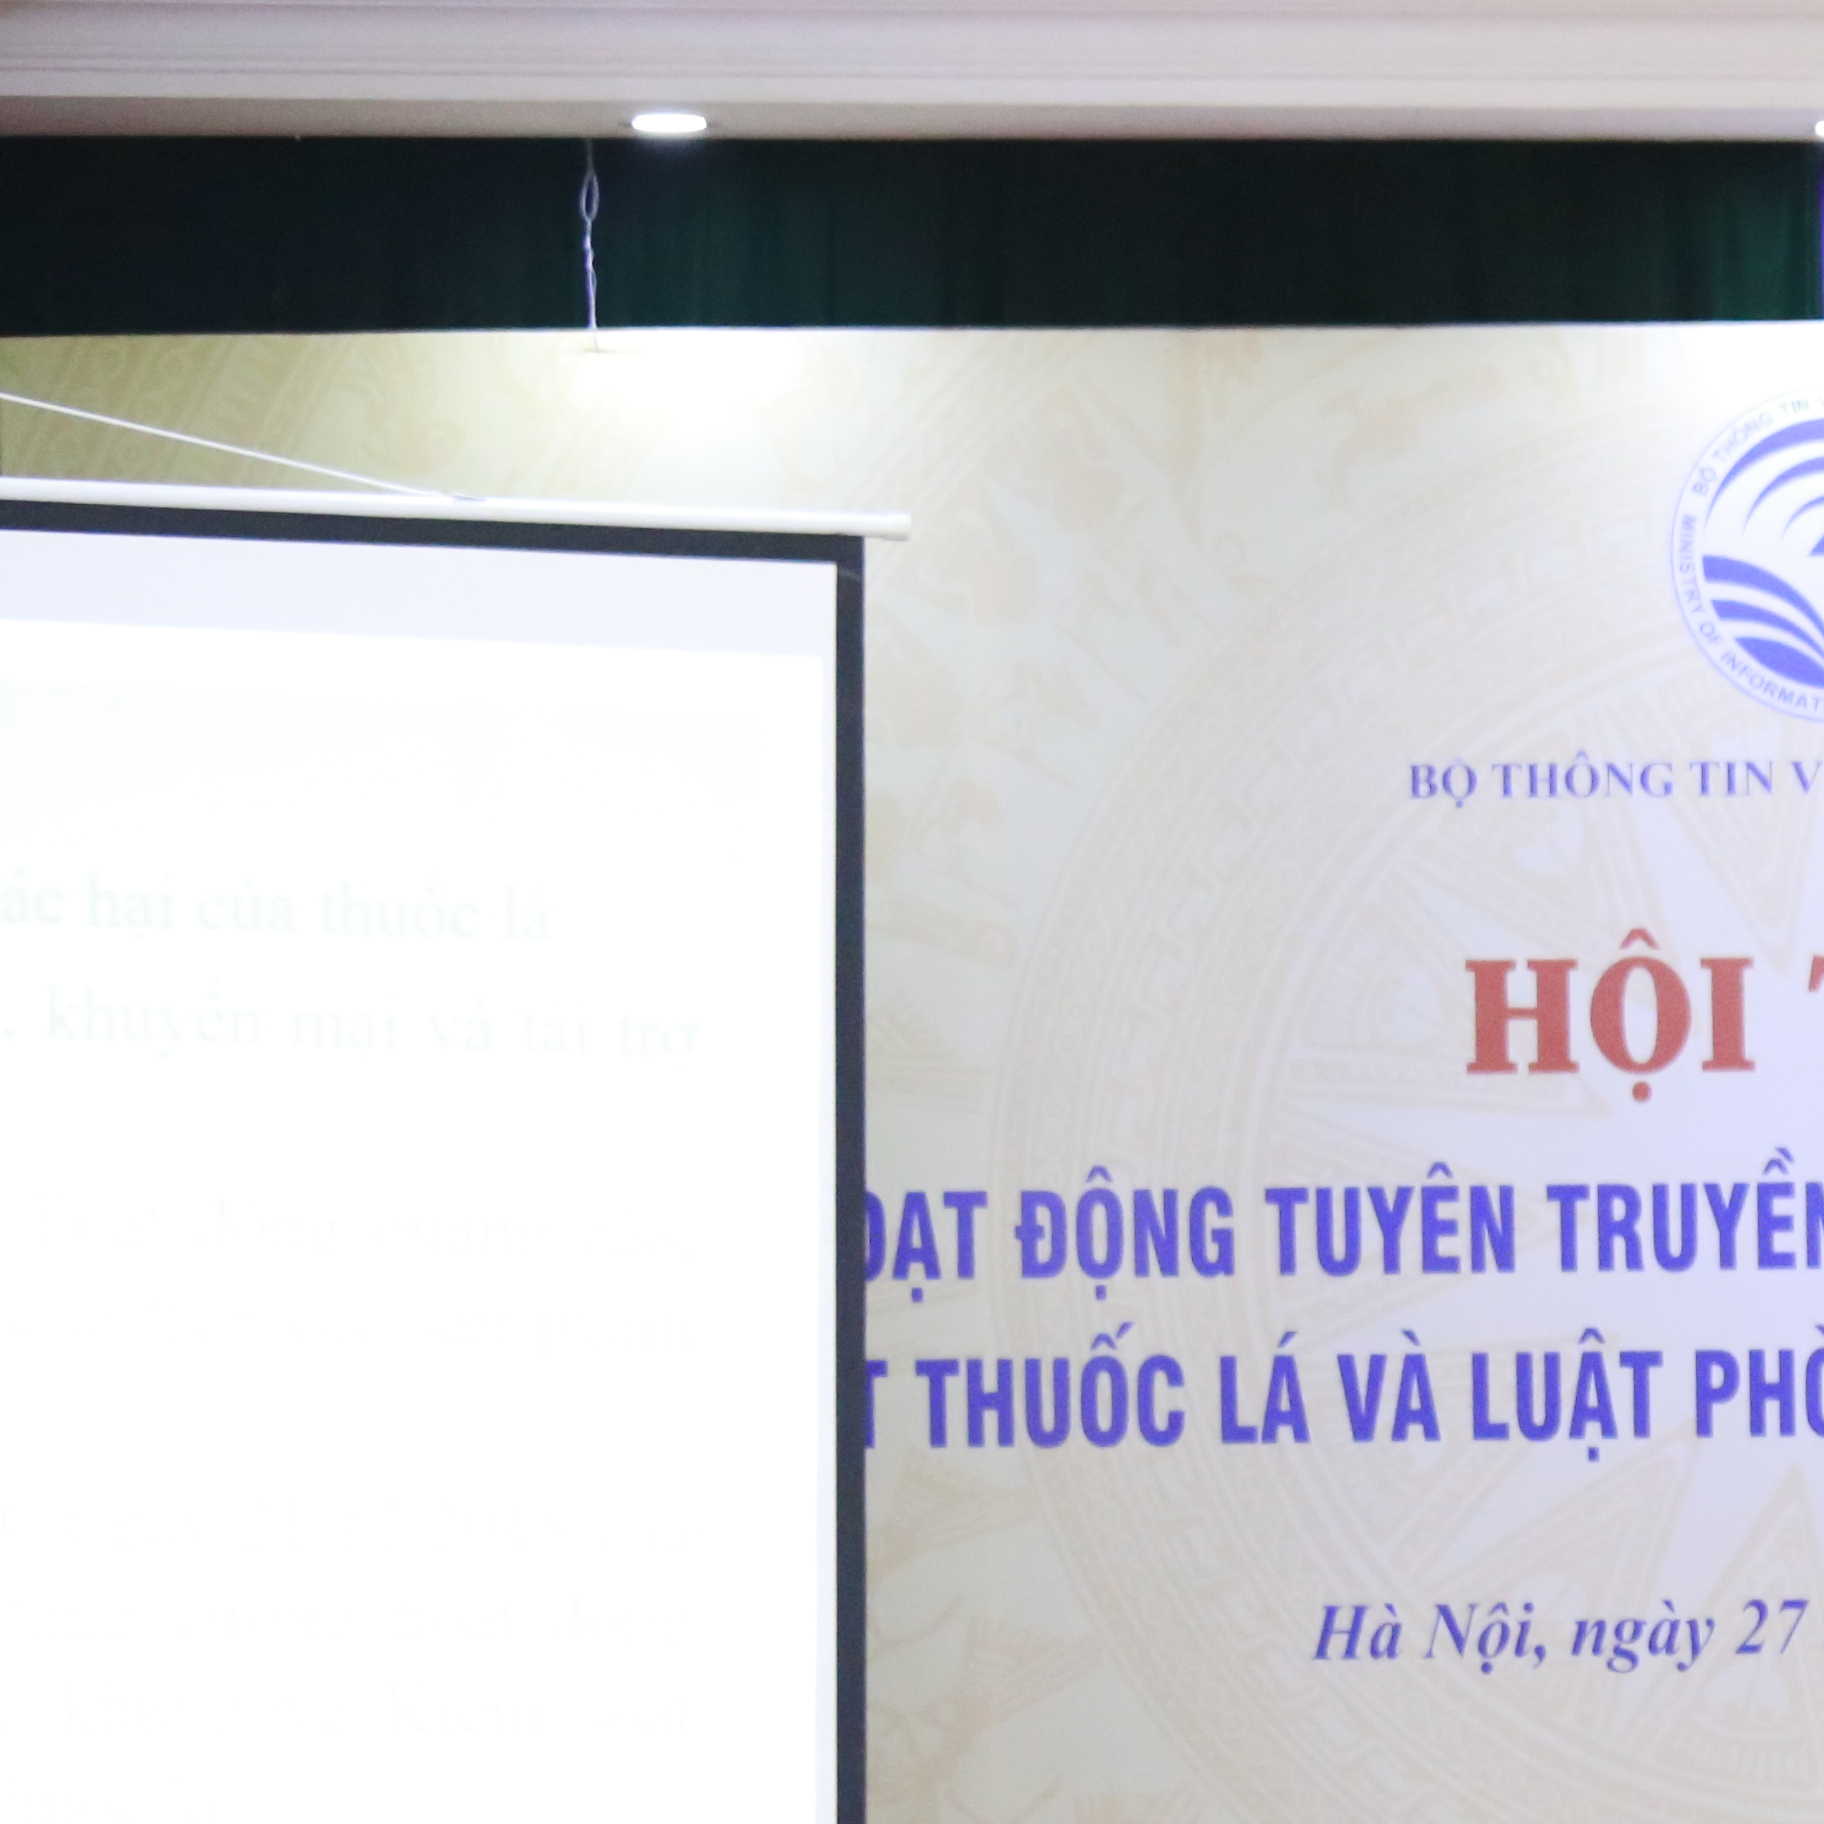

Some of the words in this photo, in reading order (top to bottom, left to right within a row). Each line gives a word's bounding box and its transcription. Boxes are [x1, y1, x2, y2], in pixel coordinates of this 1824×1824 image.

[1410, 757, 1479, 809] BỘ
[1492, 748, 1676, 800] THÔNG
[1690, 760, 1775, 797] TIN
[1465, 928, 1754, 1100] HỘI
[1015, 1166, 1234, 1300] ĐỘNG
[1267, 1162, 1516, 1276] TUYÊN
[915, 1323, 1184, 1448] THUỐC
[1221, 1332, 1310, 1443] LÁ
[1338, 1330, 1440, 1443] VÀ
[1473, 1328, 1663, 1461] LUẬT
[1313, 1602, 1403, 1661] Hà
[1423, 1600, 1547, 1673] Nội,
[1571, 1600, 1716, 1672] ngày
[1737, 1600, 1807, 1654] 27
